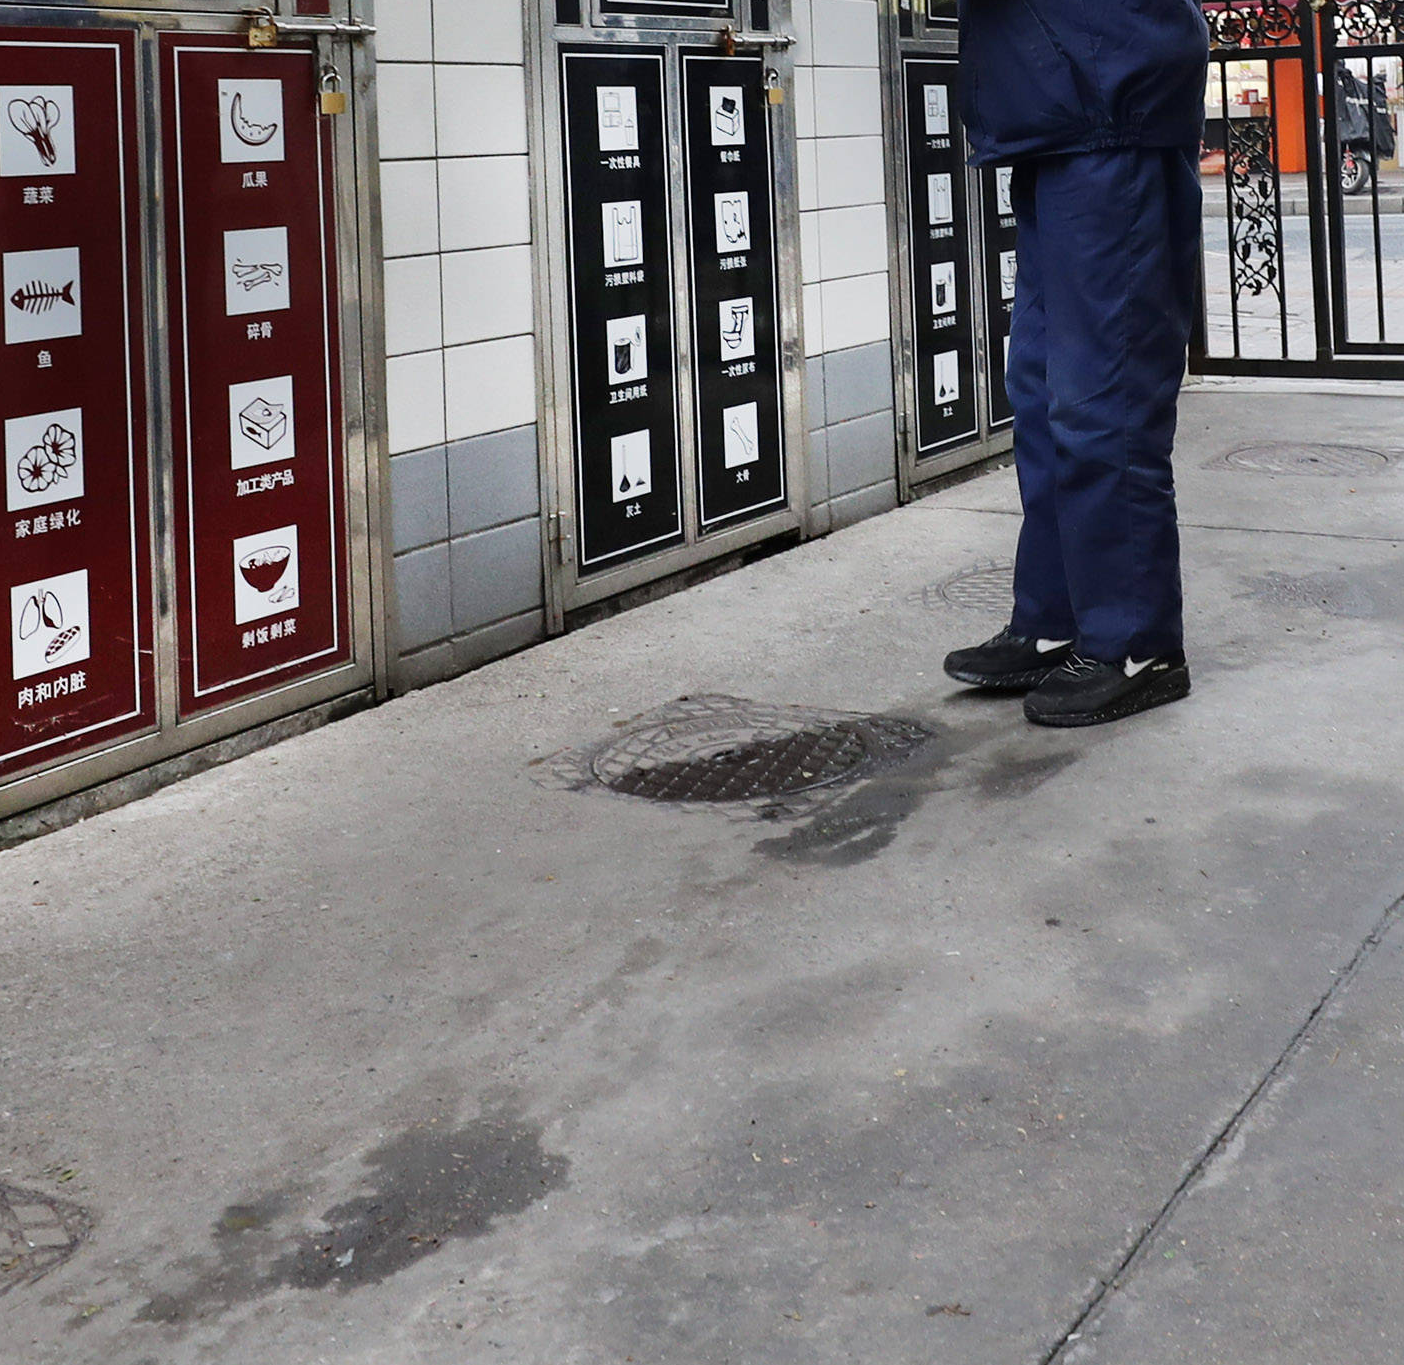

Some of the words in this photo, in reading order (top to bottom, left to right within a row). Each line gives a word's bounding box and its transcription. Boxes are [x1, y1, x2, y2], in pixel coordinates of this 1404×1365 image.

[241, 170, 269, 189] 瓜果
[22, 185, 55, 205] 蔬菜
[246, 321, 273, 341] 碎骨
[37, 350, 53, 369] 鱼
[236, 468, 295, 497] 加工类产品
[14, 508, 82, 538] 家庭绿化
[241, 617, 297, 649] 剩饭剩菜
[17, 670, 87, 710] 肉和内脏
